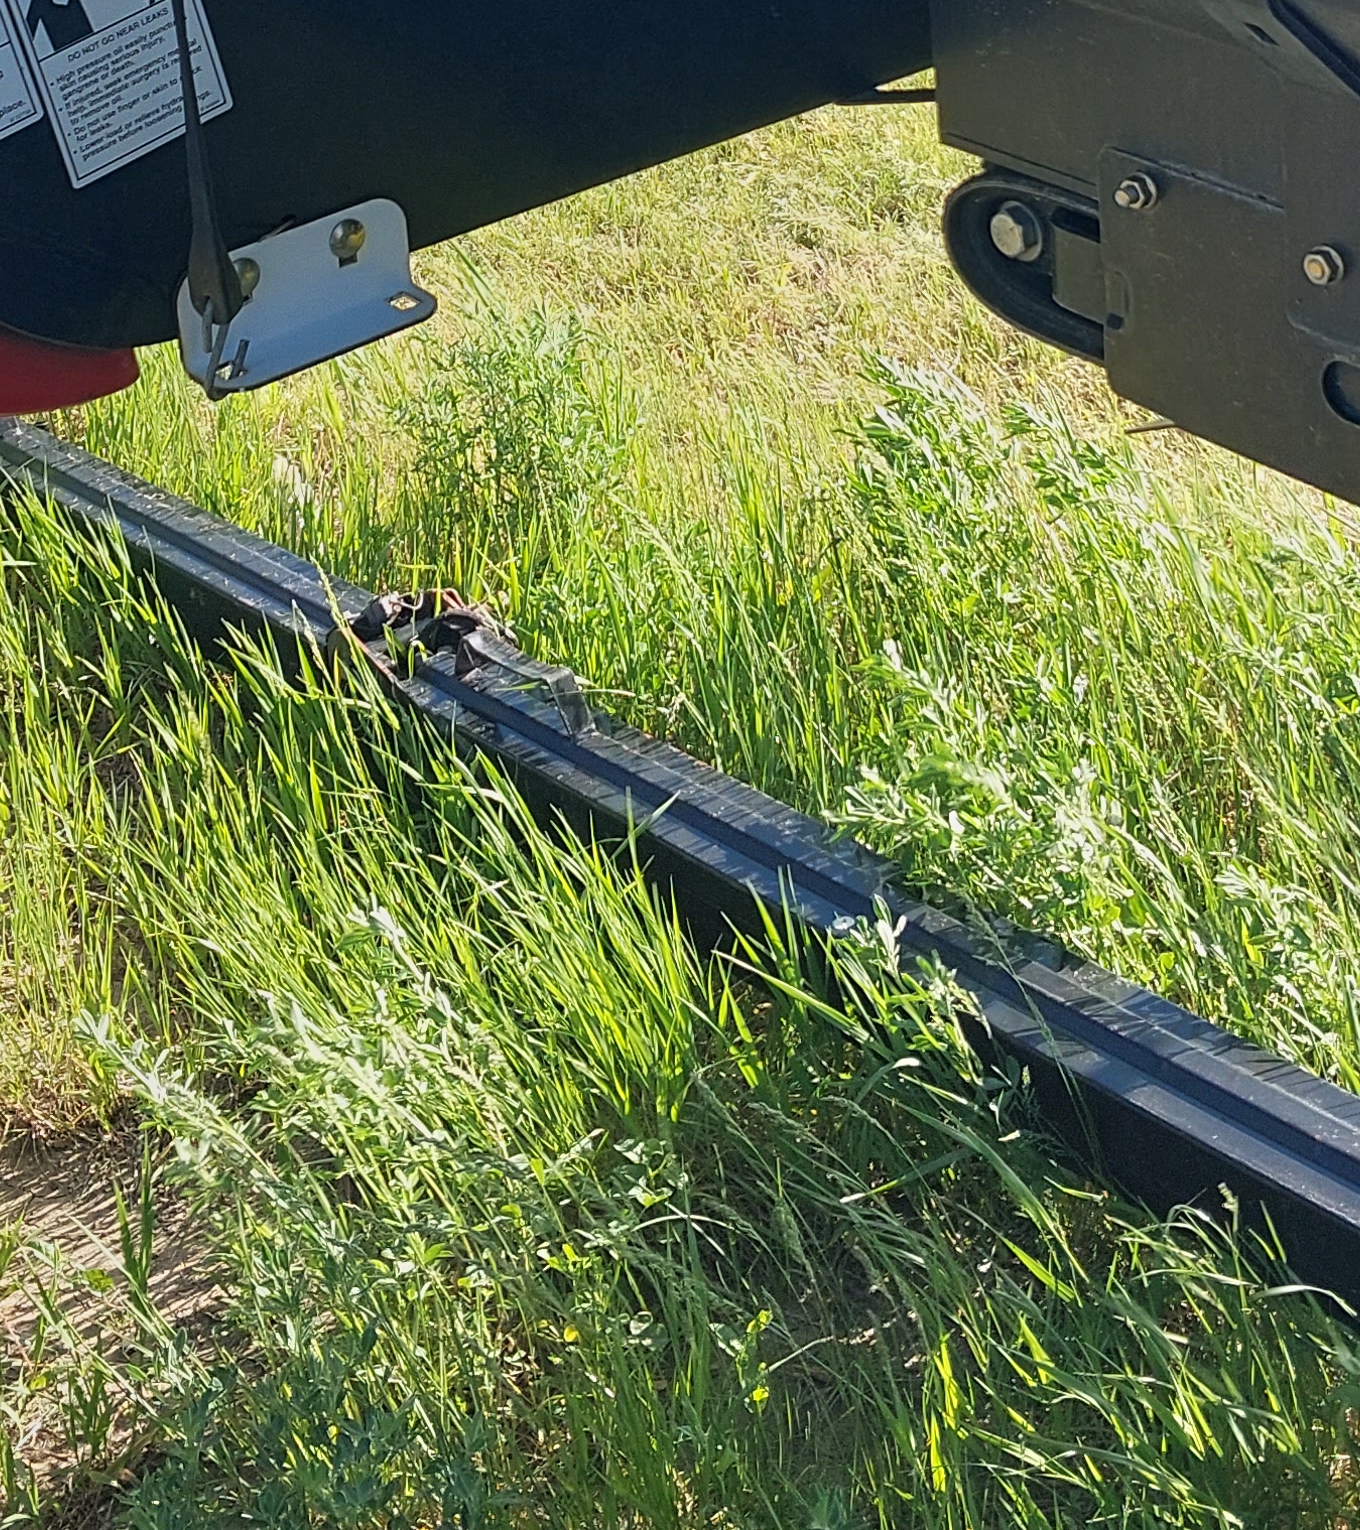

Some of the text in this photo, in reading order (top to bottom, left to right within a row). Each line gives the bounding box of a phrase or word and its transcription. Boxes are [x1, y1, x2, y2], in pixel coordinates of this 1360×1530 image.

[67, 8, 169, 62] DO NOT GO NEAR LEAKS
